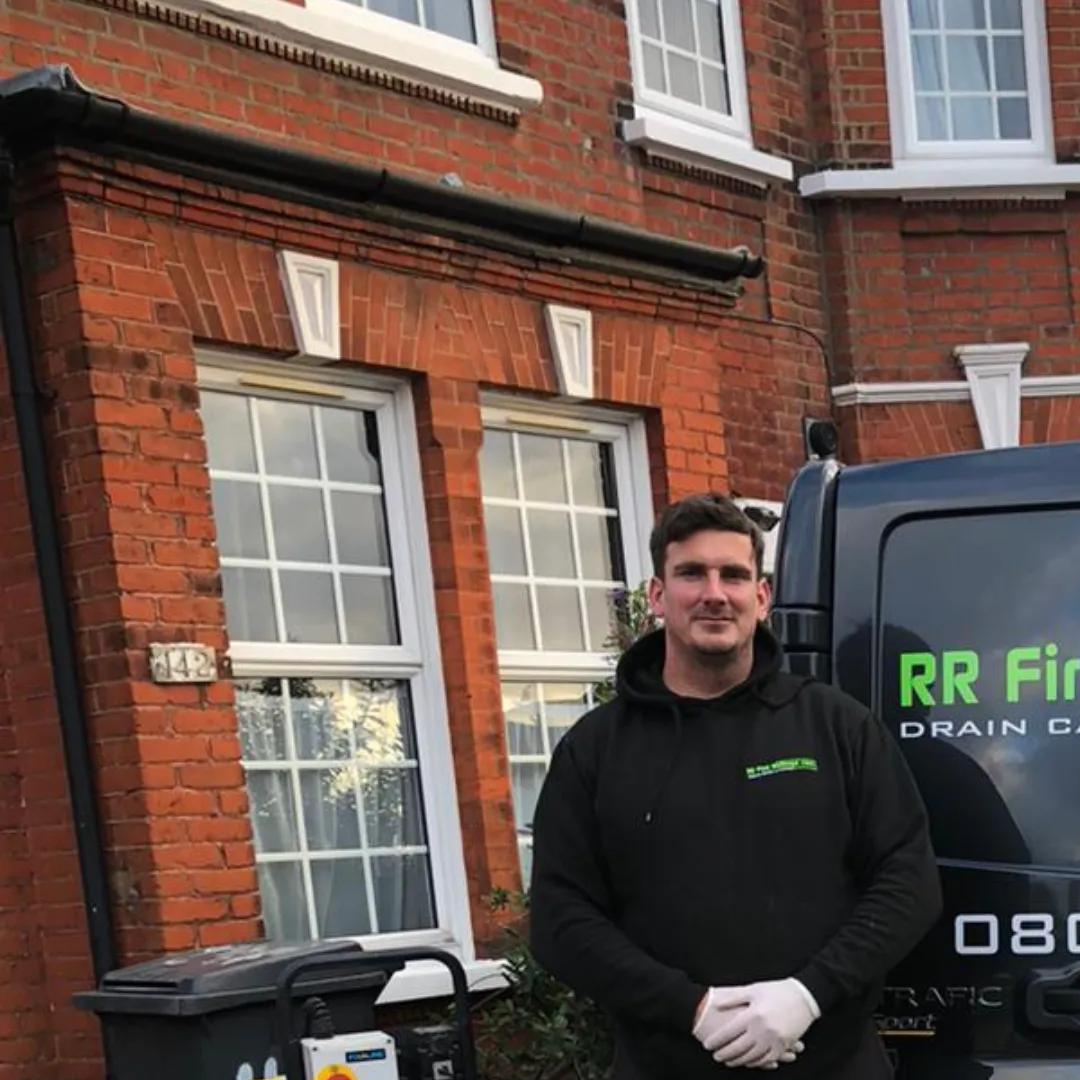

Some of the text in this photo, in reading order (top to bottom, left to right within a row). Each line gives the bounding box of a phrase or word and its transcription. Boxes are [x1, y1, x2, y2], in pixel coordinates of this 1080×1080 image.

[901, 650, 979, 707] RR
[901, 719, 1027, 739] DRAIN
[882, 986, 1002, 1007] TRAFIC
